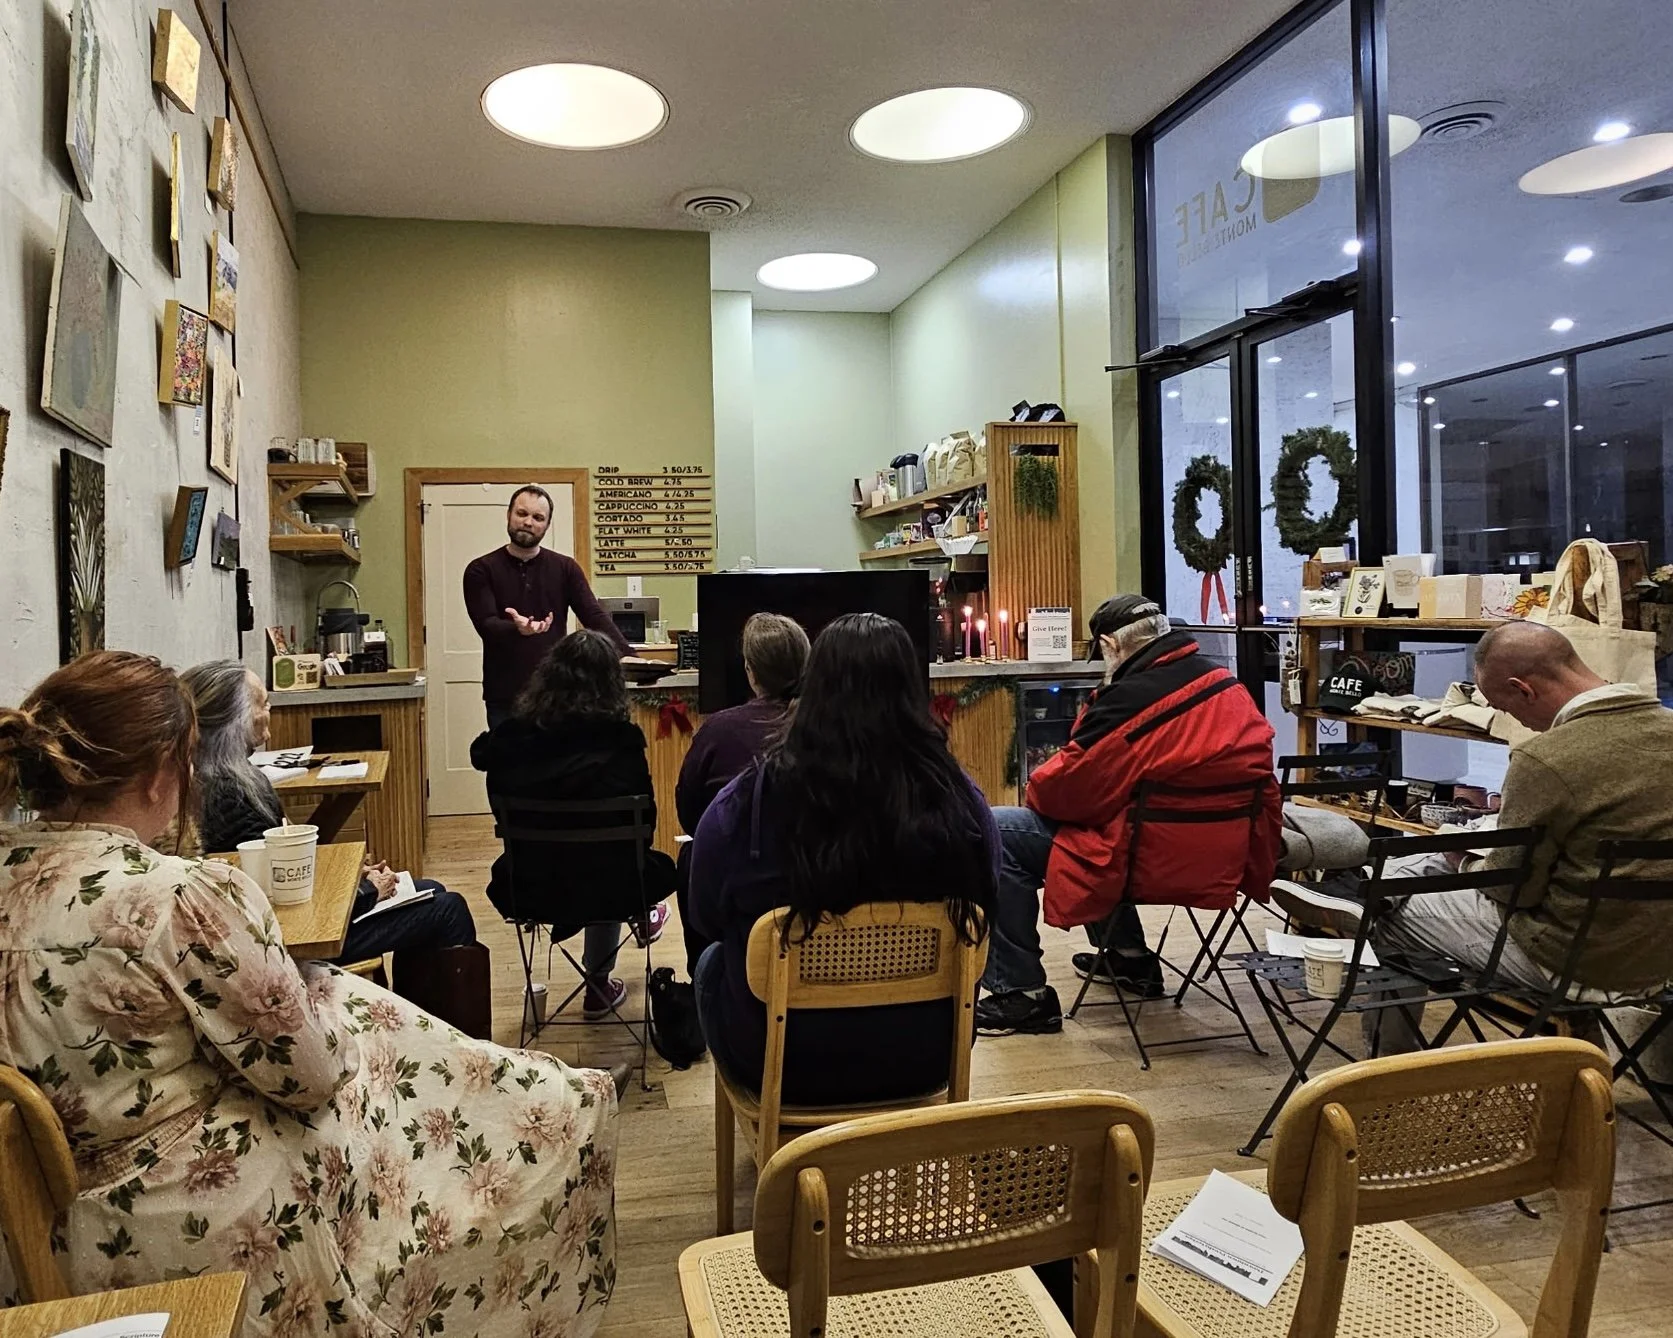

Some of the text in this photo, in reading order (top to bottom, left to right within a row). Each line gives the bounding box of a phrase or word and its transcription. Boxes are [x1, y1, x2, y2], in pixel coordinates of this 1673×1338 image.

[598, 466, 619, 474] DRIP
[598, 478, 682, 486] COLD BREW 4.75
[598, 490, 652, 498] AMERICANO
[597, 502, 685, 511] CAPPUCCINO 4.25
[597, 514, 643, 523] CORTADO
[598, 527, 620, 535] FLAT
[622, 526, 652, 535] WHITE
[598, 539, 625, 547] LATTE
[598, 551, 637, 559] MATCHA
[598, 563, 616, 571] TEA
[1330, 676, 1363, 692] CAFE
[286, 864, 312, 878] CAFE
